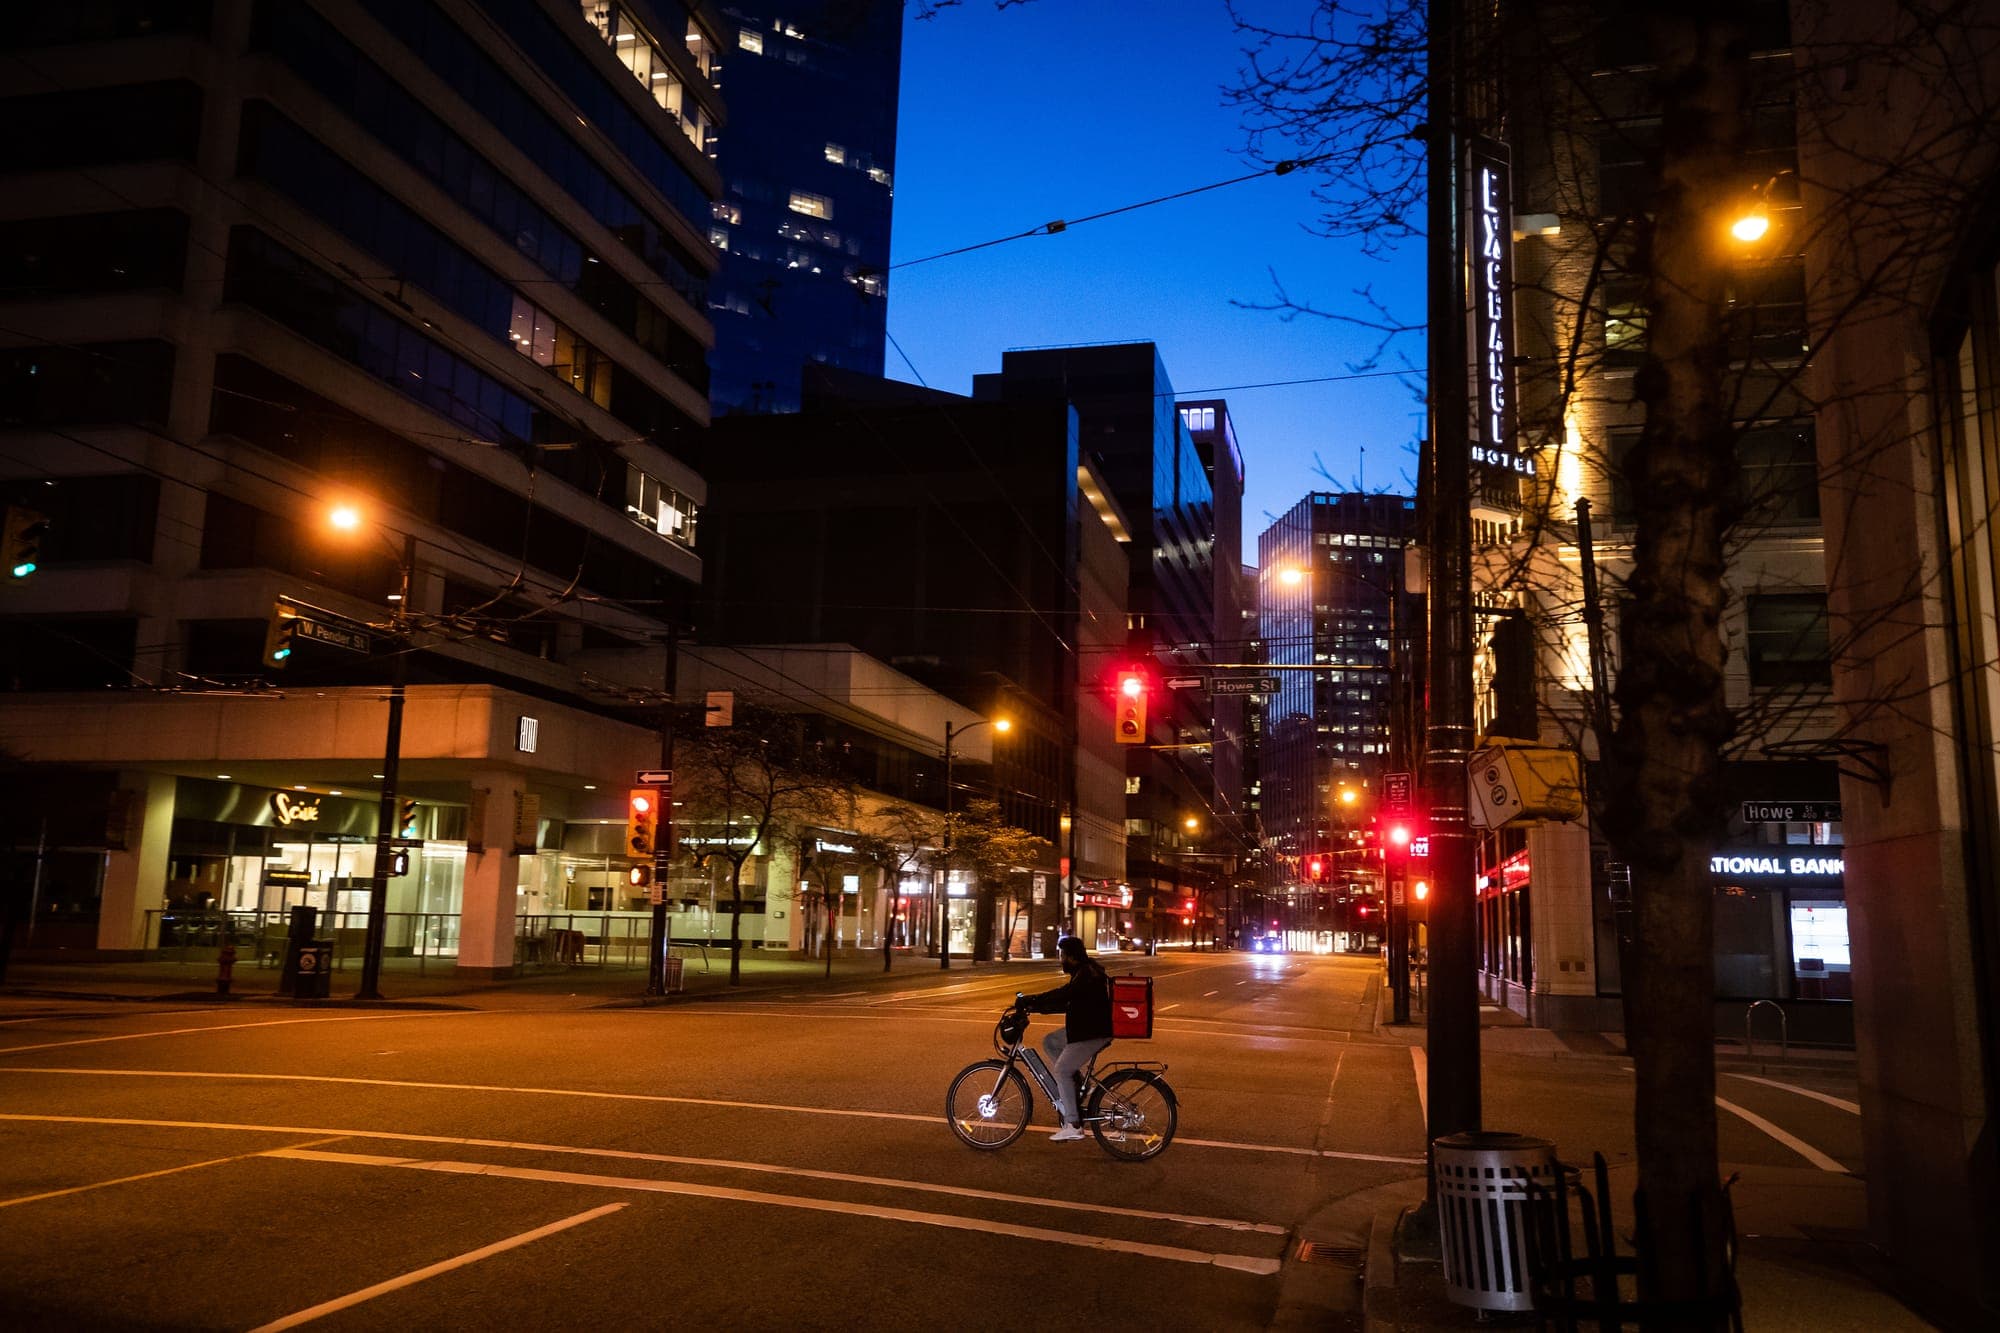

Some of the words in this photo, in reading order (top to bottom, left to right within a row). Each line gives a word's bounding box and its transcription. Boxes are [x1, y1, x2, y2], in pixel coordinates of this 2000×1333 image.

[1472, 446, 1536, 475] HOTEL
[303, 621, 313, 634] W
[316, 624, 351, 646] Pender
[353, 633, 365, 649] St
[1217, 680, 1254, 692] Howe
[1260, 679, 1275, 691] St
[1749, 805, 1793, 819] Howe
[1804, 804, 1813, 812] St
[1790, 857, 1845, 874] BANK
